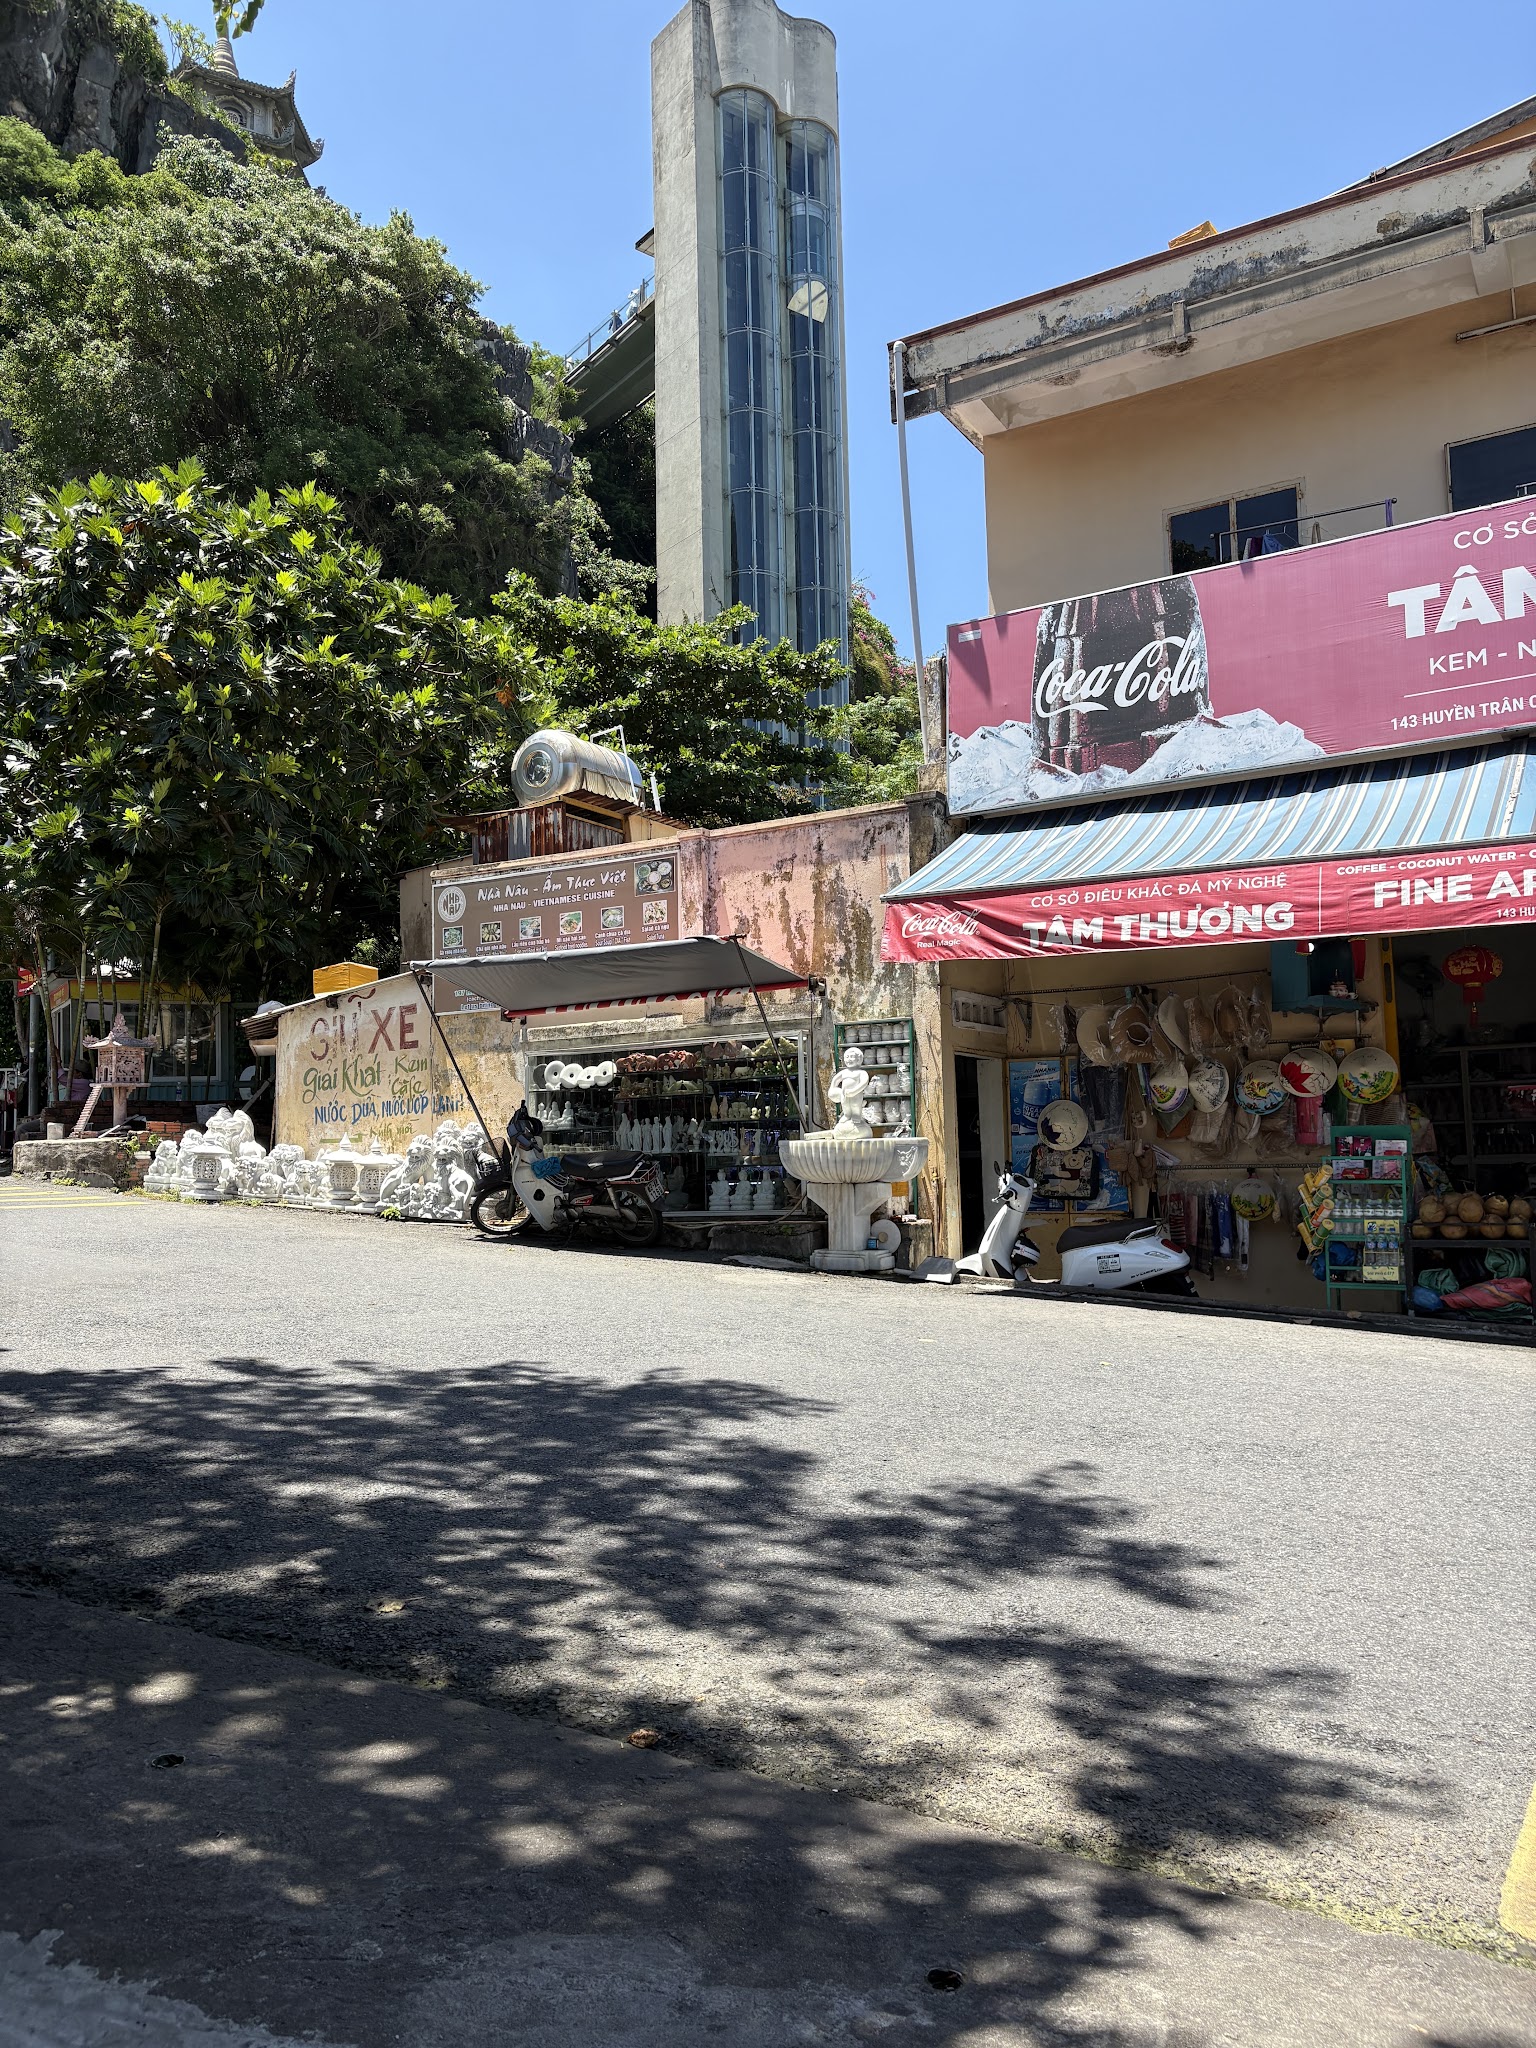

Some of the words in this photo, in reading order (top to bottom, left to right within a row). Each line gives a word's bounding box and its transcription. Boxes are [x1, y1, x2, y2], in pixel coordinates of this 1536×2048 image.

[1453, 523, 1494, 549] CƠ
[1035, 635, 1204, 718] Coca-Cola
[1429, 648, 1487, 675] KEM
[1390, 716, 1418, 731] 143
[1422, 704, 1475, 726] HUYỀN
[1479, 697, 1524, 717] TRÂN
[1337, 863, 1386, 876] COFFEE
[1397, 856, 1464, 870] COCONUT
[1467, 851, 1516, 864] WATER
[477, 887, 500, 902] Nhà
[505, 884, 529, 898] Nâu
[542, 871, 562, 894] Ẩm
[566, 875, 596, 891] Thực
[600, 869, 627, 887] Việt
[1031, 893, 1053, 908] CƠ
[1057, 889, 1080, 906] SỞ
[1084, 887, 1122, 904] ĐIÊU
[1127, 883, 1173, 899] KHẮC
[1178, 880, 1202, 895] ĐÁ
[1207, 877, 1233, 892] MỸ
[1237, 872, 1287, 889] NGHỆ
[1374, 874, 1474, 908] FINE
[493, 904, 509, 913] NHA
[511, 902, 526, 911] NAU
[533, 893, 581, 907] VIETNAMESE
[584, 889, 616, 901] CUISINE
[1496, 908, 1517, 919] 143
[1022, 915, 1104, 949] TÂM
[1113, 901, 1295, 941] THƯƠNG
[917, 941, 935, 949] Real
[936, 938, 961, 948] Magic
[368, 1003, 419, 1054] XE
[394, 1054, 428, 1074] Kem
